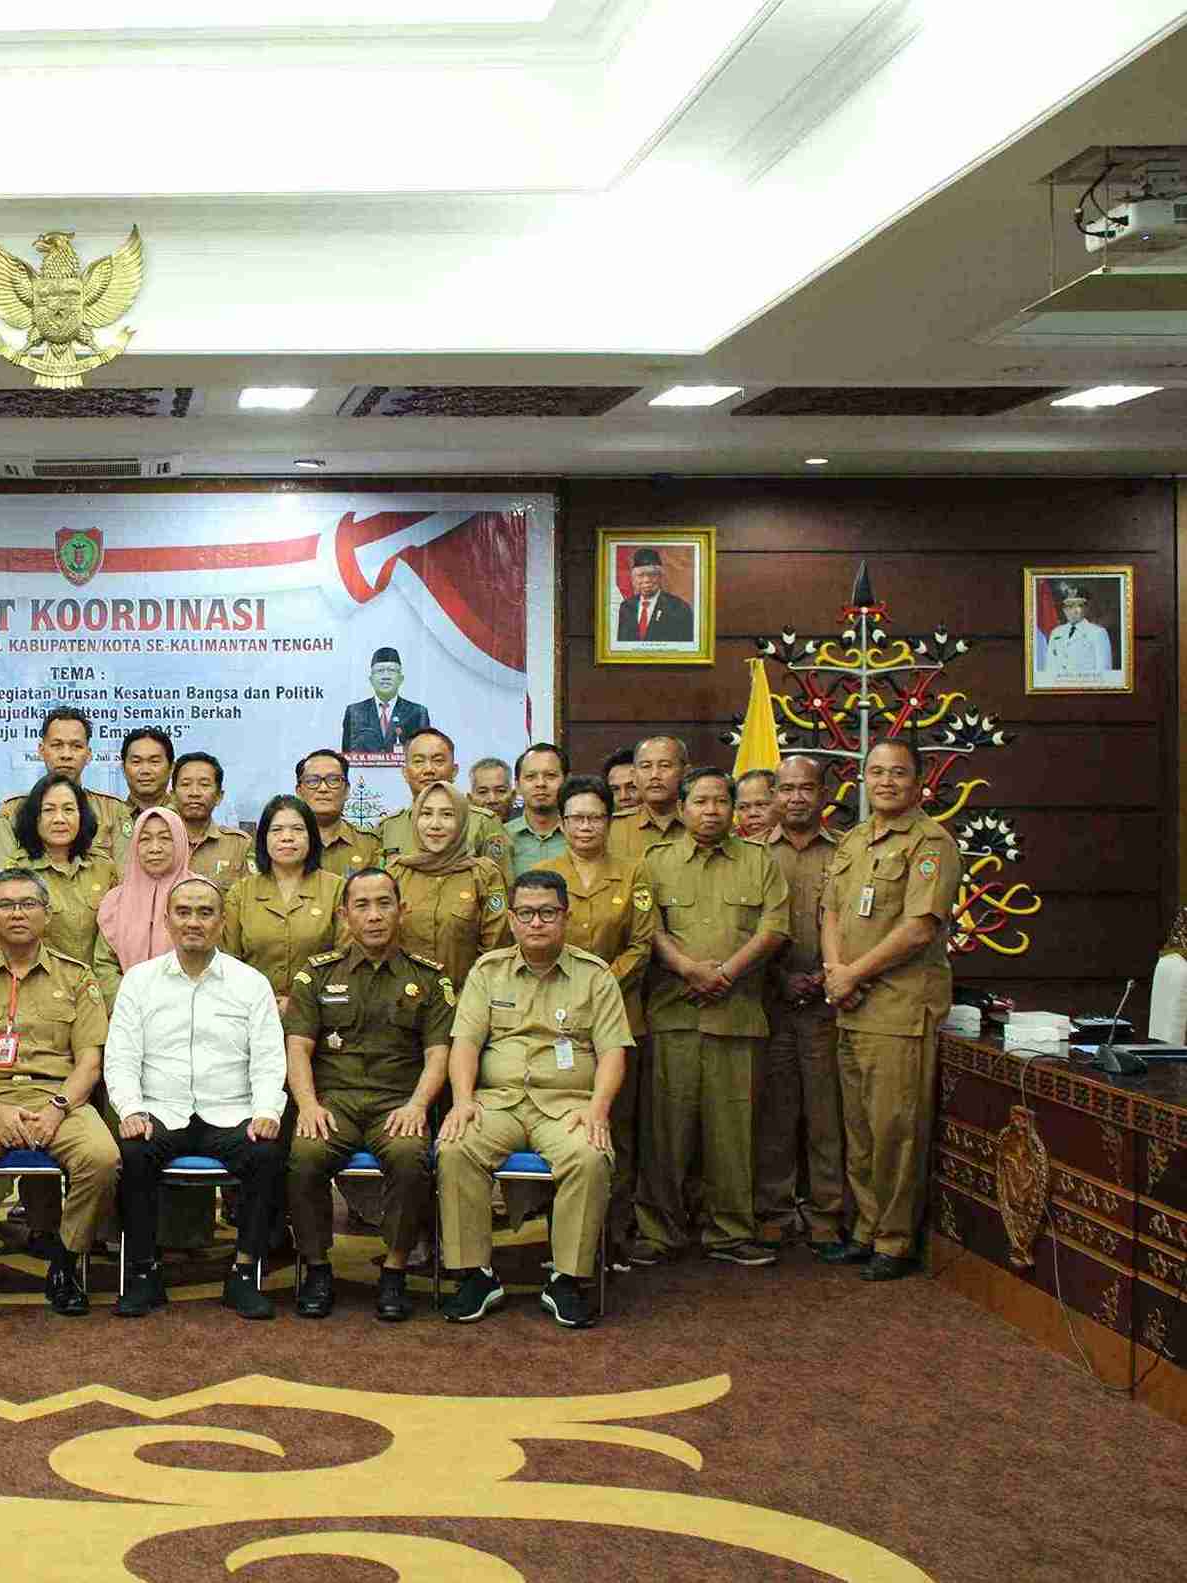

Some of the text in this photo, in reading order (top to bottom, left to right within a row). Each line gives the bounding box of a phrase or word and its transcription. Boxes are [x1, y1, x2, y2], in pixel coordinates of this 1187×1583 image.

[30, 598, 267, 632] KOORDINASI
[9, 638, 141, 652] KABUPATEN/KOTA
[146, 638, 268, 652] SE-KALIMANTAN
[272, 637, 334, 652] TENGAH
[50, 666, 95, 681] TEMA
[57, 685, 108, 700] Urusan
[113, 685, 181, 700] Kesatuan
[186, 685, 239, 703] Bangsa
[243, 685, 271, 700] dan
[275, 685, 325, 700] Politik
[123, 705, 185, 720] Semakin
[190, 705, 242, 720] Berkah
